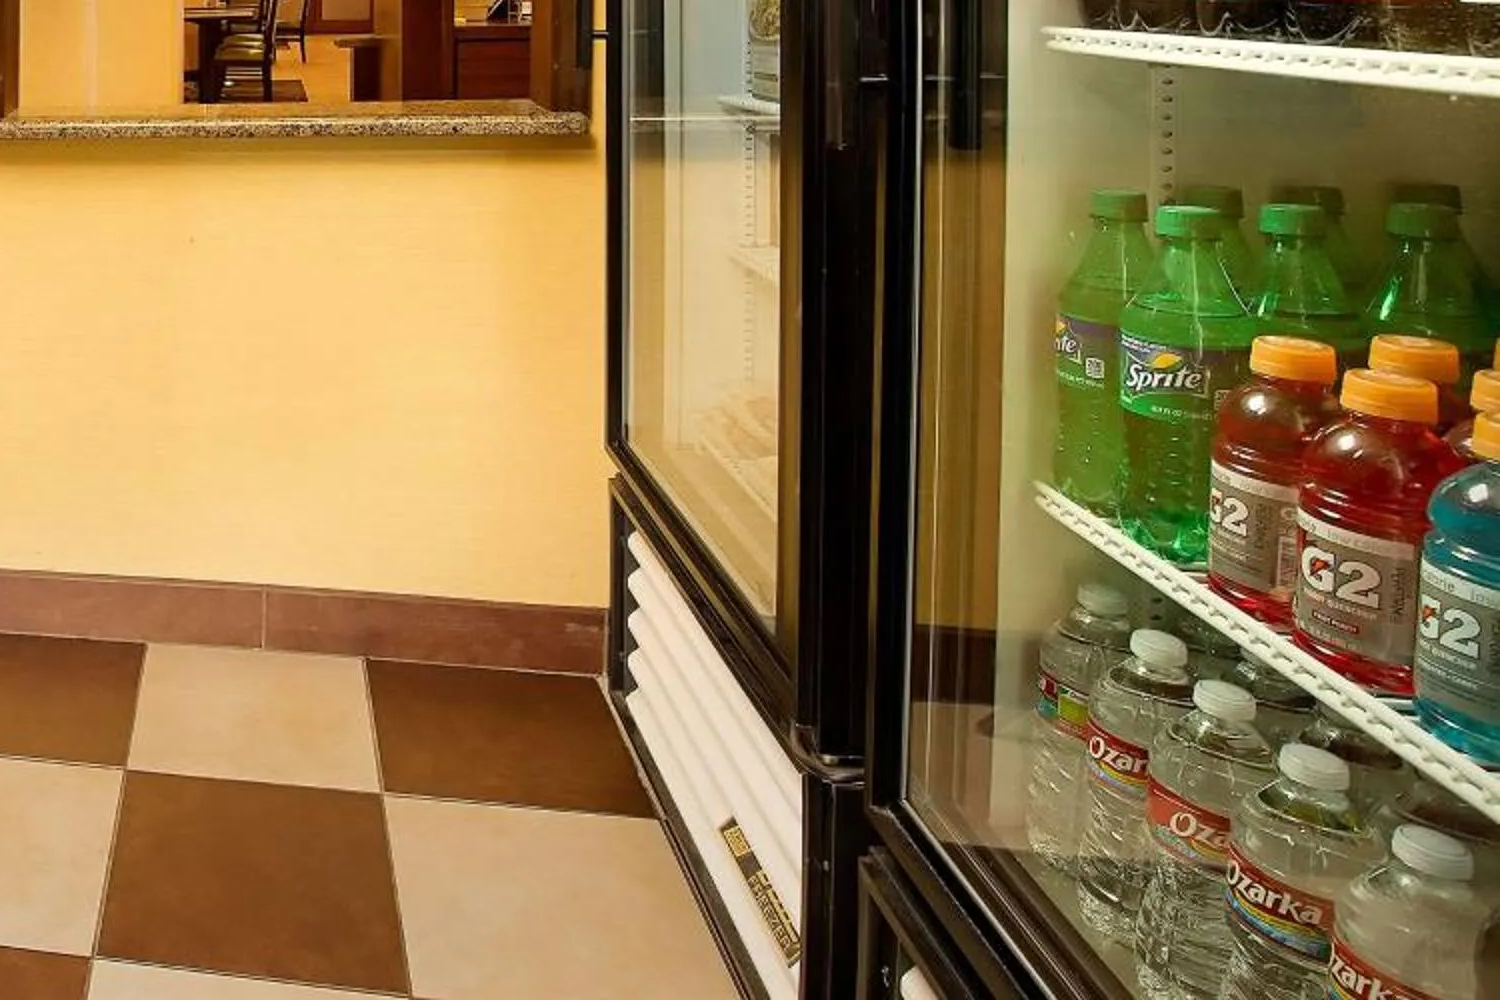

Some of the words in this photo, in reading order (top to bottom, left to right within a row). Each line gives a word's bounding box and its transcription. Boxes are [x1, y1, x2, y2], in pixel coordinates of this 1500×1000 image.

[1126, 363, 1202, 392] Sprite
[1301, 544, 1382, 610] G2
[1089, 735, 1148, 775] Ozar
[1169, 812, 1229, 848] Oza
[1226, 859, 1323, 925] Ozarka
